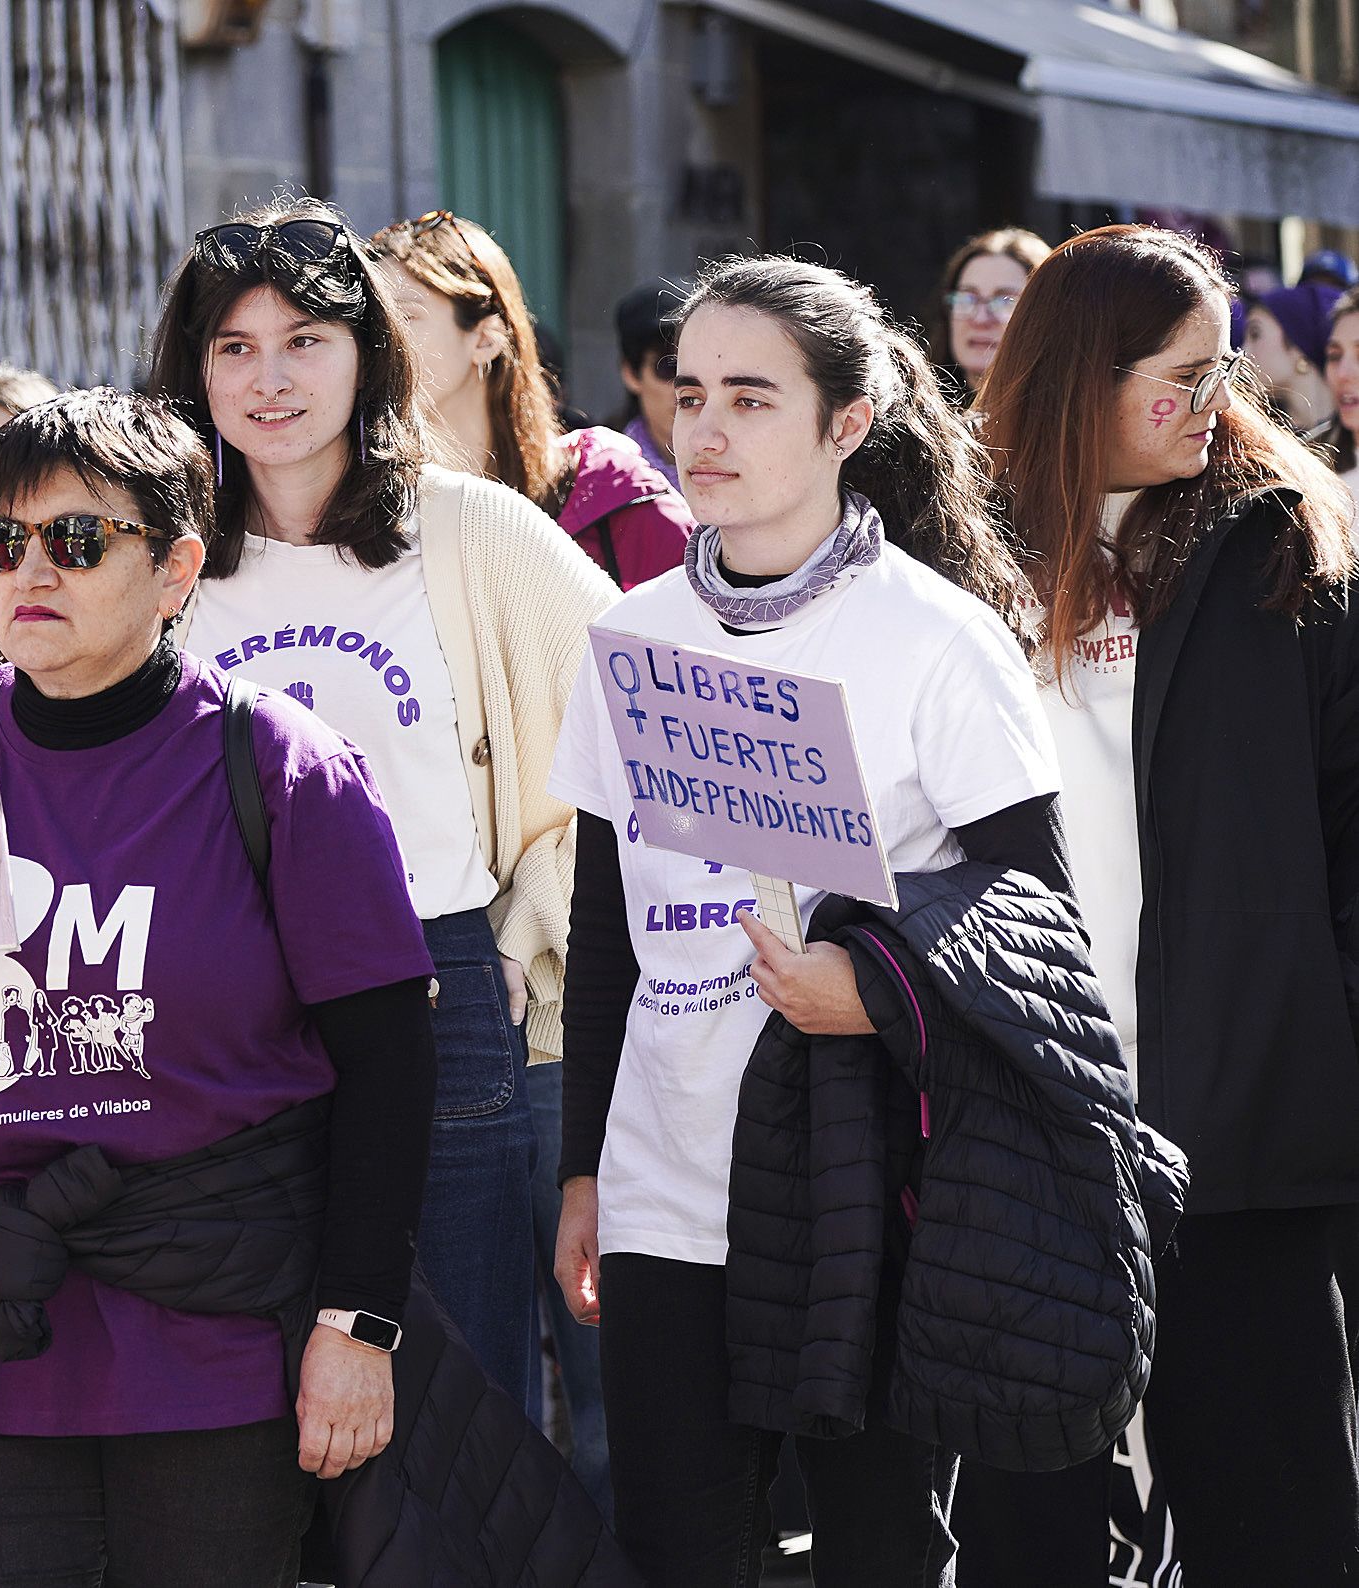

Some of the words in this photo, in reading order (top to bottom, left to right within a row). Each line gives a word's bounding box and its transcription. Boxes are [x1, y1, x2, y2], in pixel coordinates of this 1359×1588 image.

[215, 624, 421, 727] ERÉMONOS
[660, 715, 828, 785] FUERTES
[646, 899, 760, 931] LIBRE
[661, 1001, 680, 1016] de
[745, 982, 760, 998] d
[69, 1104, 89, 1119] de
[93, 1098, 151, 1117] Vilaboa
